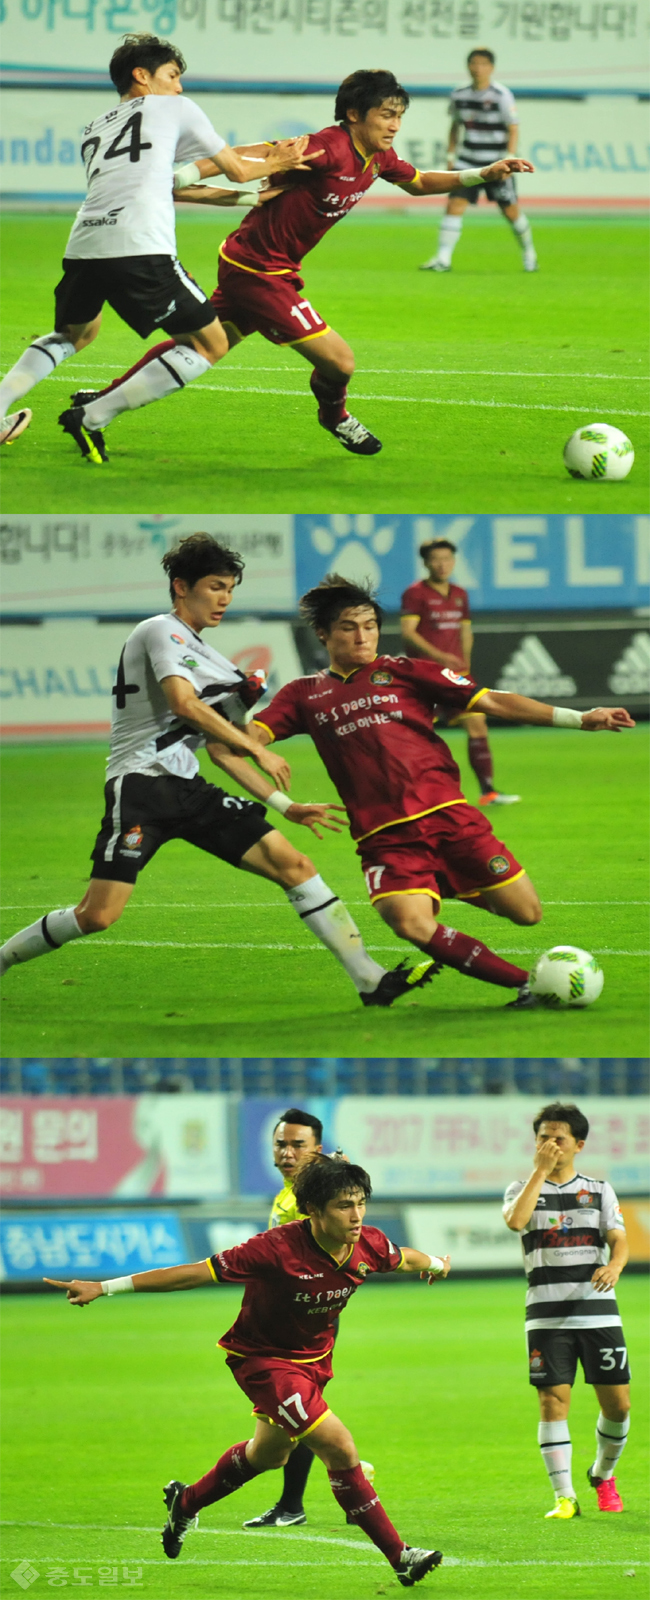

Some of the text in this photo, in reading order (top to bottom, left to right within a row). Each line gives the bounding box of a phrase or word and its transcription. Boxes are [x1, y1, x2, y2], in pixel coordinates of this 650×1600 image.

[290, 300, 323, 331] 17
[341, 692, 399, 717] Daejeon
[538, 1229, 595, 1250] Bravo
[599, 1346, 628, 1371] 37
[277, 1391, 309, 1429] 17
